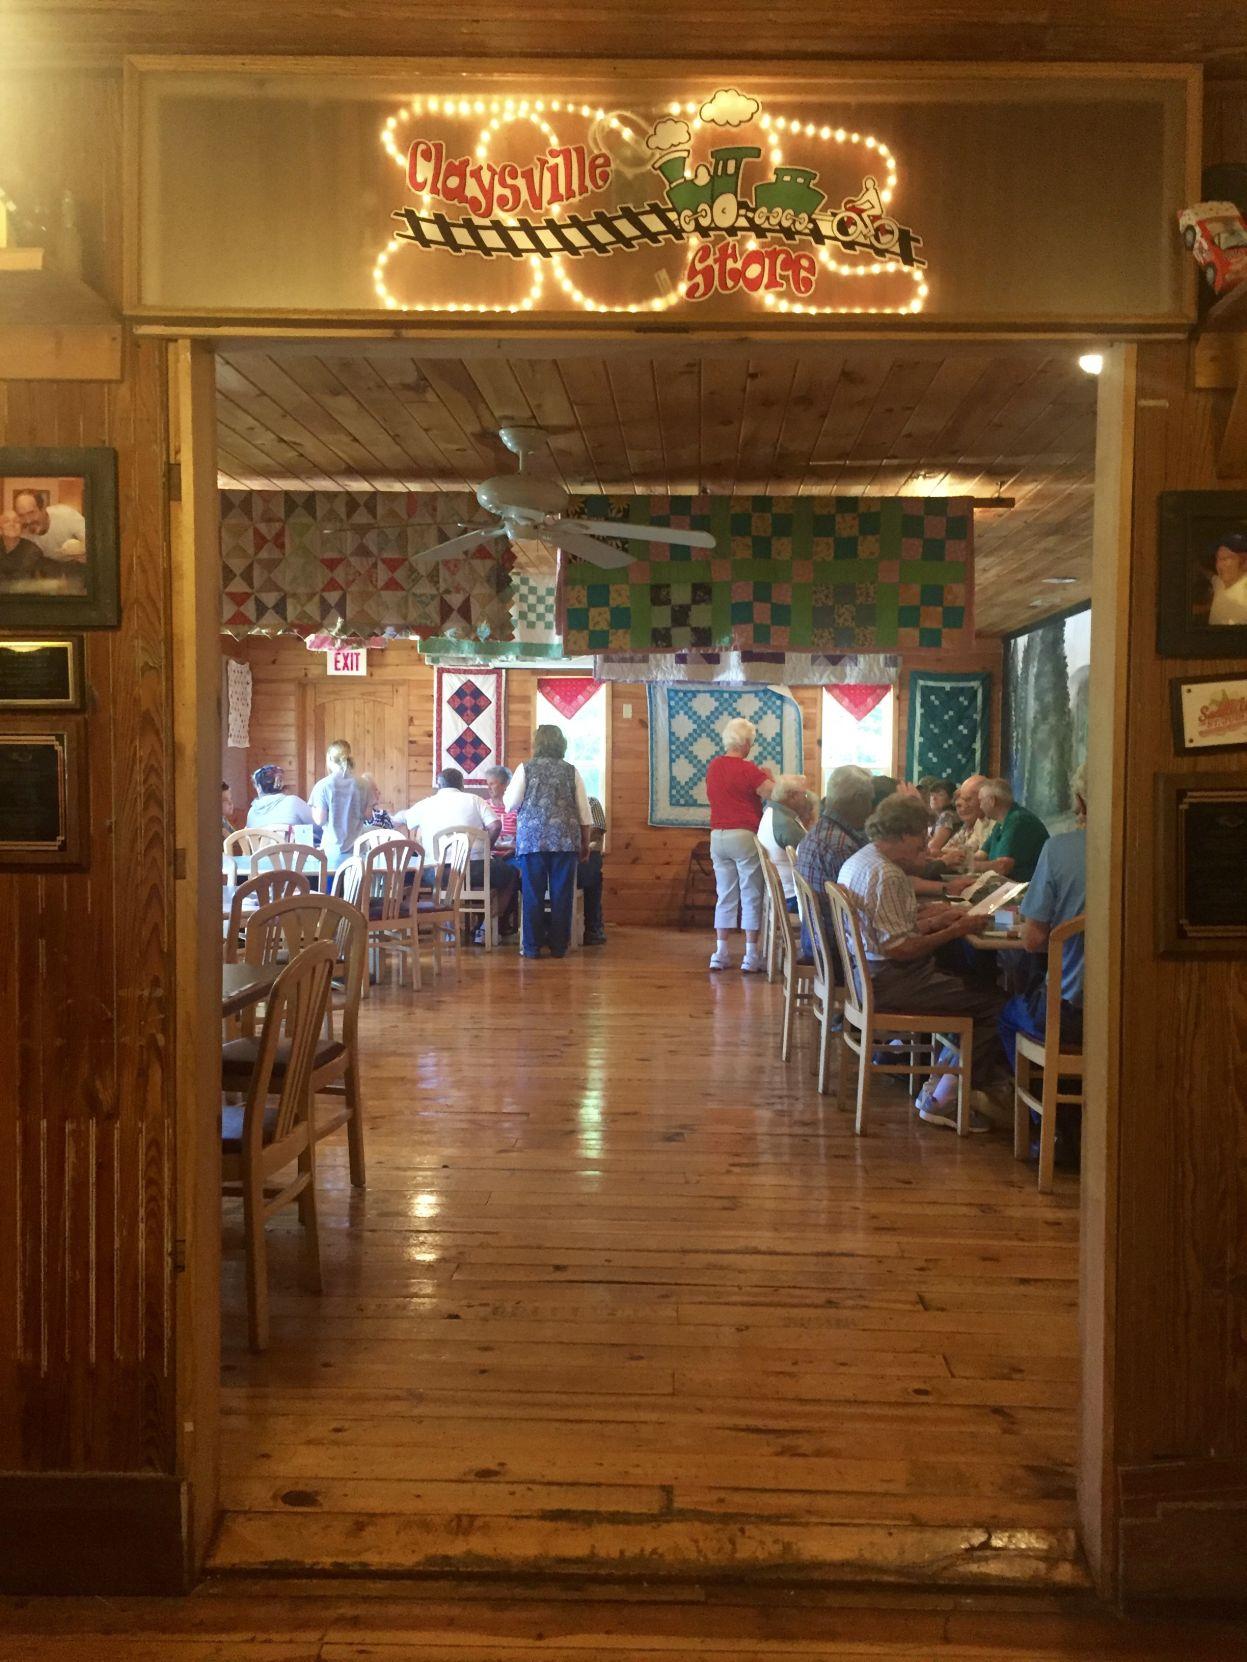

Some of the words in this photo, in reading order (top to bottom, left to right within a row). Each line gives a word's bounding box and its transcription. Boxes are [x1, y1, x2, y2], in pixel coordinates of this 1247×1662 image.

[407, 139, 612, 219] Claysville
[685, 240, 816, 299] Store
[334, 652, 361, 671] EXIT
